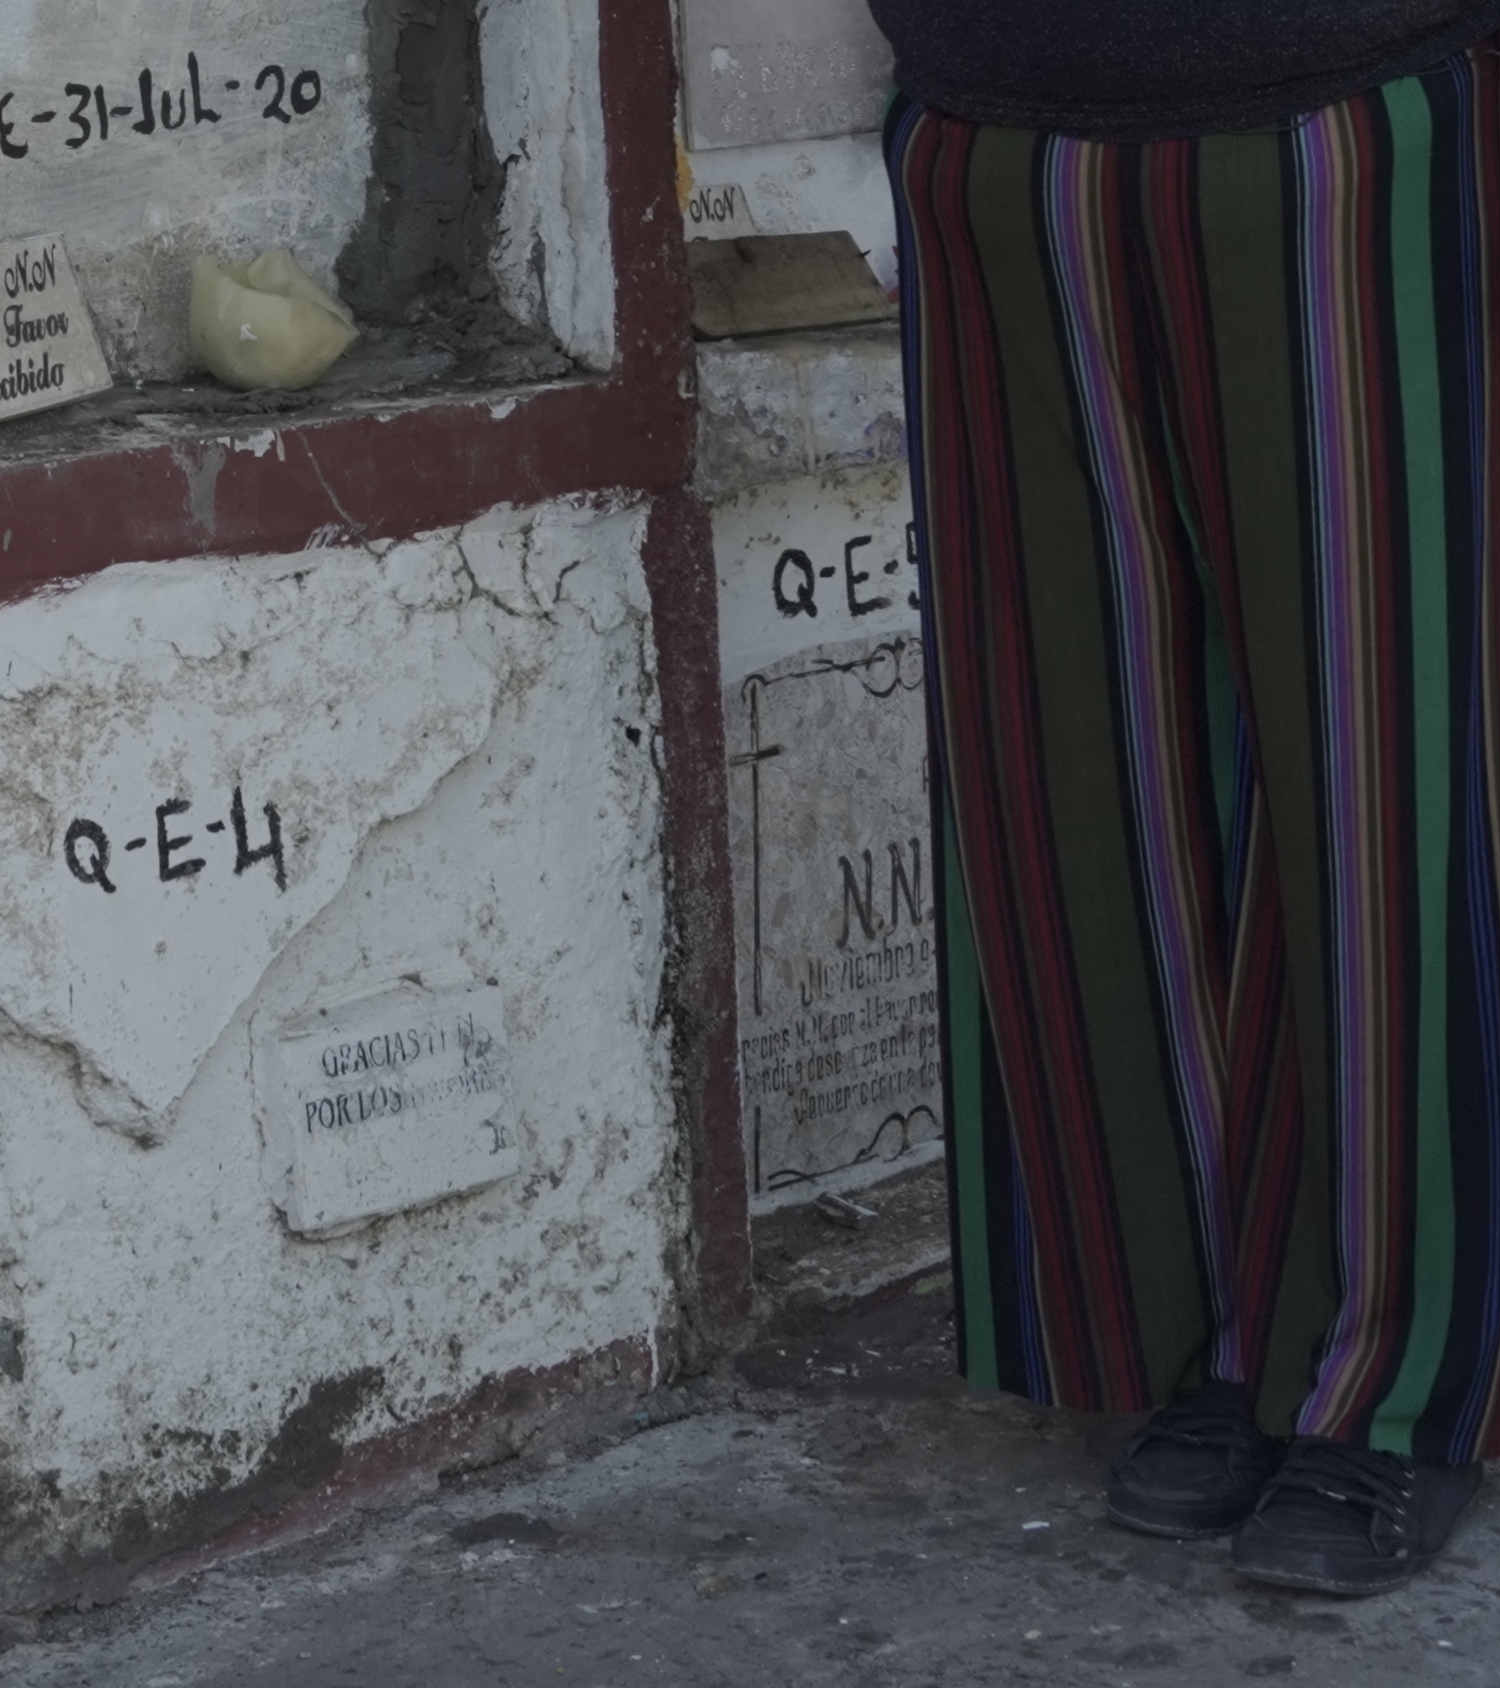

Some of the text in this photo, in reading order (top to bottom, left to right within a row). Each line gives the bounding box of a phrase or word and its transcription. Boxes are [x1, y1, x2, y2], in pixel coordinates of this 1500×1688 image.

[3, 306, 71, 352] Favor
[62, 786, 288, 895] Q-E-4
[322, 1027, 421, 1078] GRACIAS
[305, 1092, 351, 1134] POR
[356, 1085, 403, 1121] LOS
